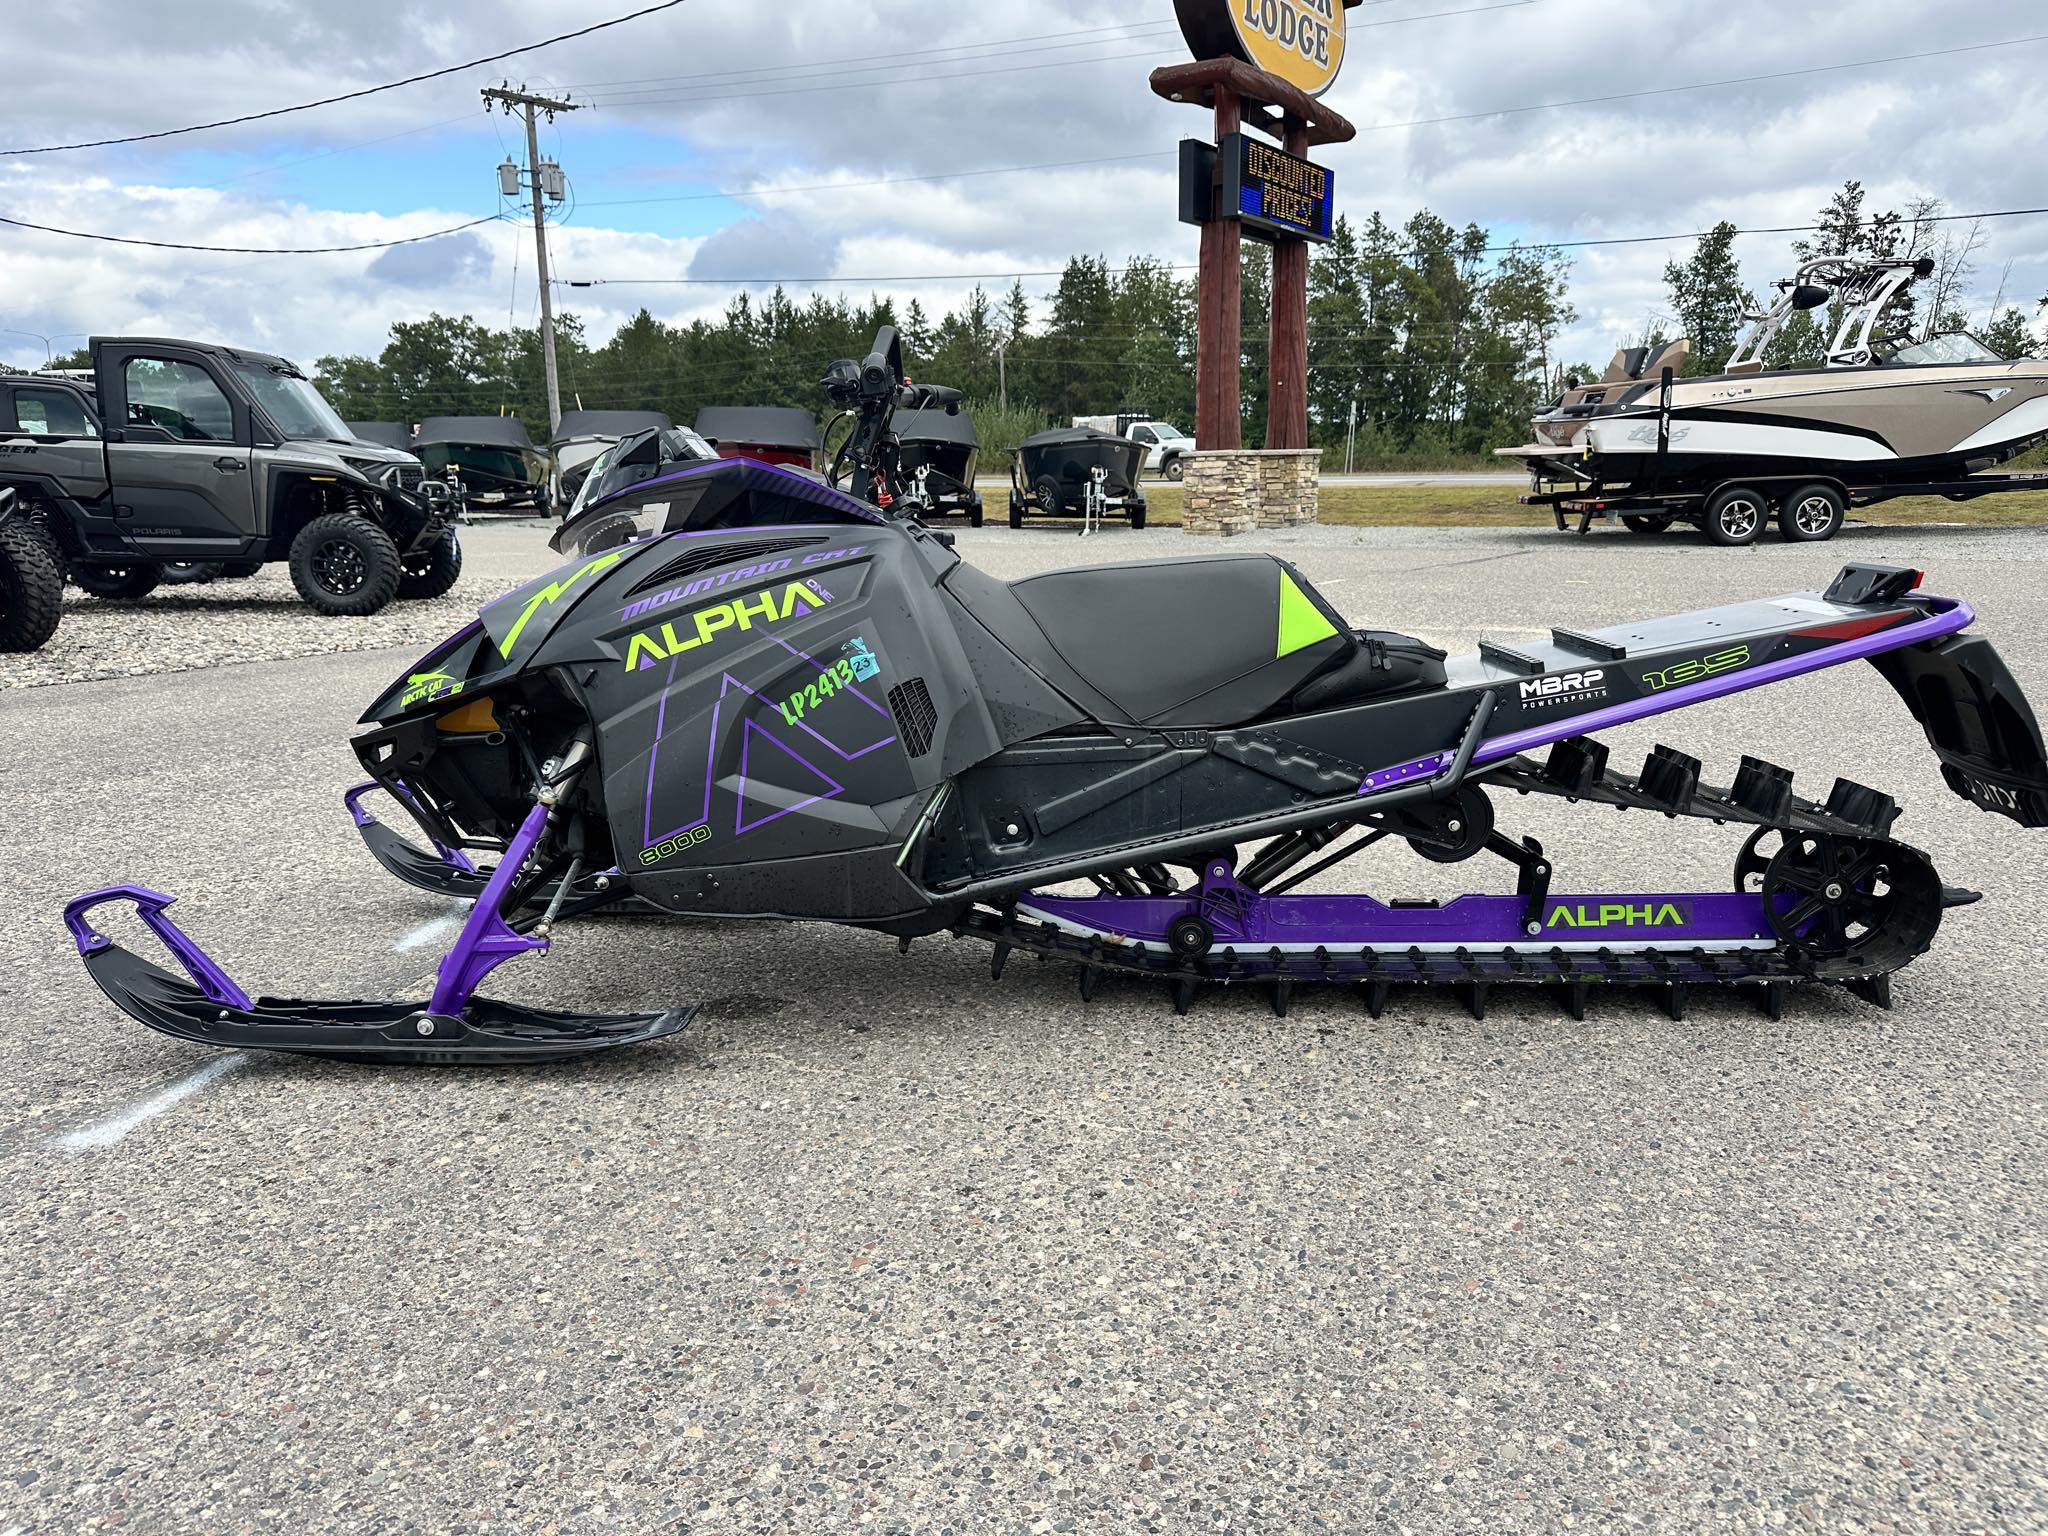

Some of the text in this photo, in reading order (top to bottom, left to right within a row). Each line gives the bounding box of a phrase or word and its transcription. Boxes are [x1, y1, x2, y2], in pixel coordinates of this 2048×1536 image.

[1244, 0, 1329, 66] LODGE
[1249, 142, 1325, 200] DISCOUNTED
[132, 527, 182, 535] POLARIS
[621, 546, 867, 622] MOUNTAIN CAT
[624, 578, 836, 673] ALPHA ONE
[853, 657, 872, 674] 23
[1519, 669, 1604, 699] MBRP
[1642, 645, 1750, 690] 165
[400, 678, 444, 708] ARCTIC CAT
[780, 659, 854, 726] LP2413
[1522, 690, 1607, 710] POWERSPORTS
[638, 824, 712, 866] 8000
[1547, 903, 1684, 927] ALPHA
